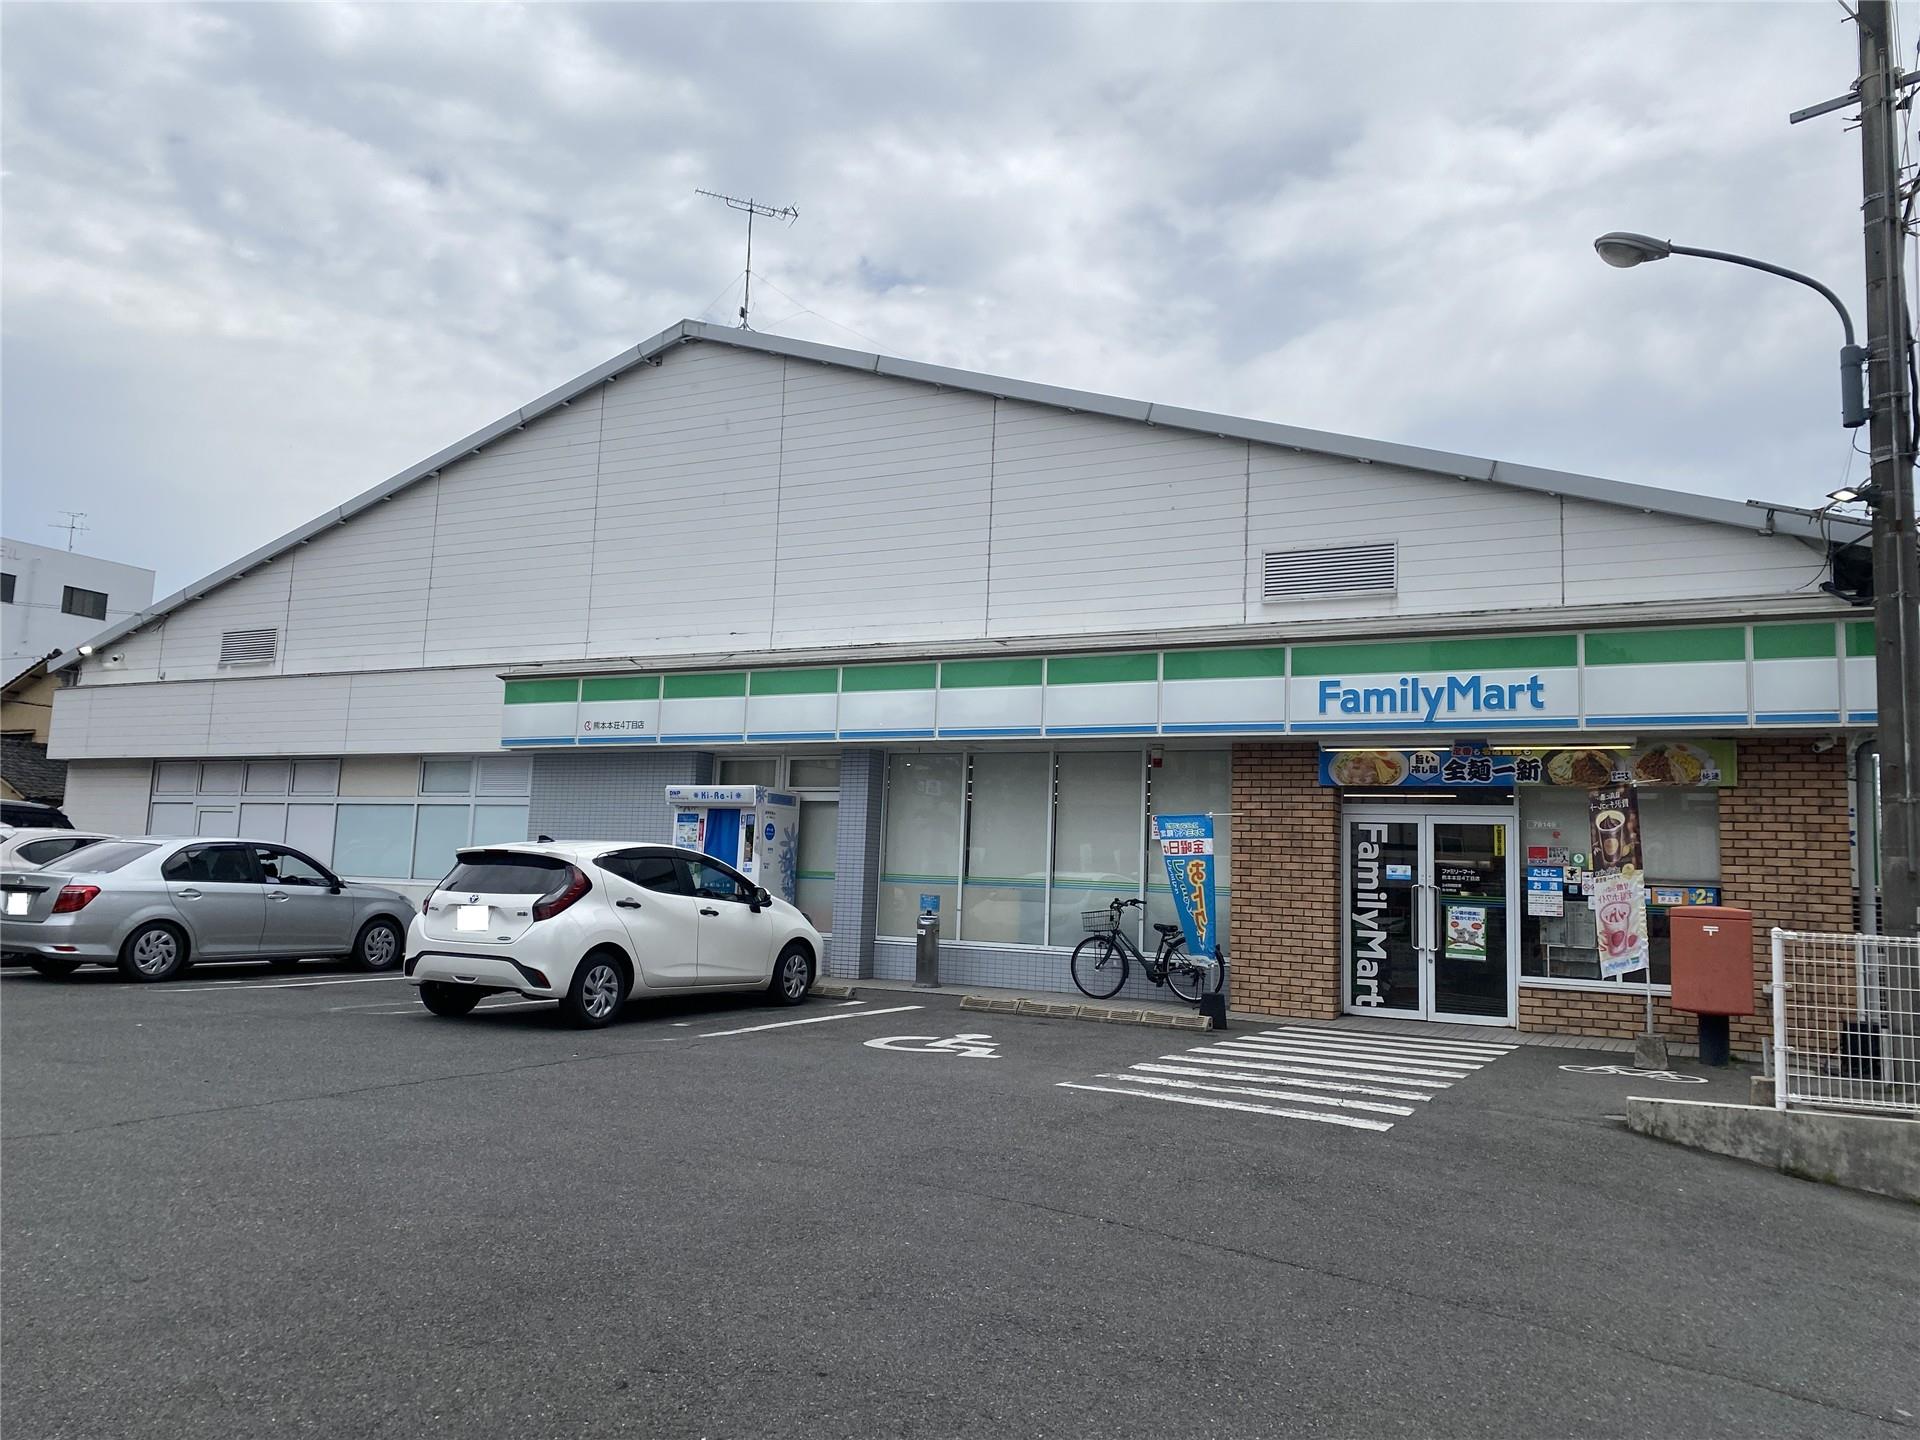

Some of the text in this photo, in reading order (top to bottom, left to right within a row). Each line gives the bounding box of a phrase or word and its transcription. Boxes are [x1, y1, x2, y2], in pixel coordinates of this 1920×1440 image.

[1318, 674, 1545, 722] FamilyMart
[593, 720, 645, 730] 熊本本荘4丁目店
[1415, 754, 1436, 765] 旨い
[1442, 757, 1543, 782] 全麺一新
[1533, 868, 1557, 877] たばこ
[1533, 882, 1558, 890] お酒
[1352, 823, 1388, 1007] FamilyMart
